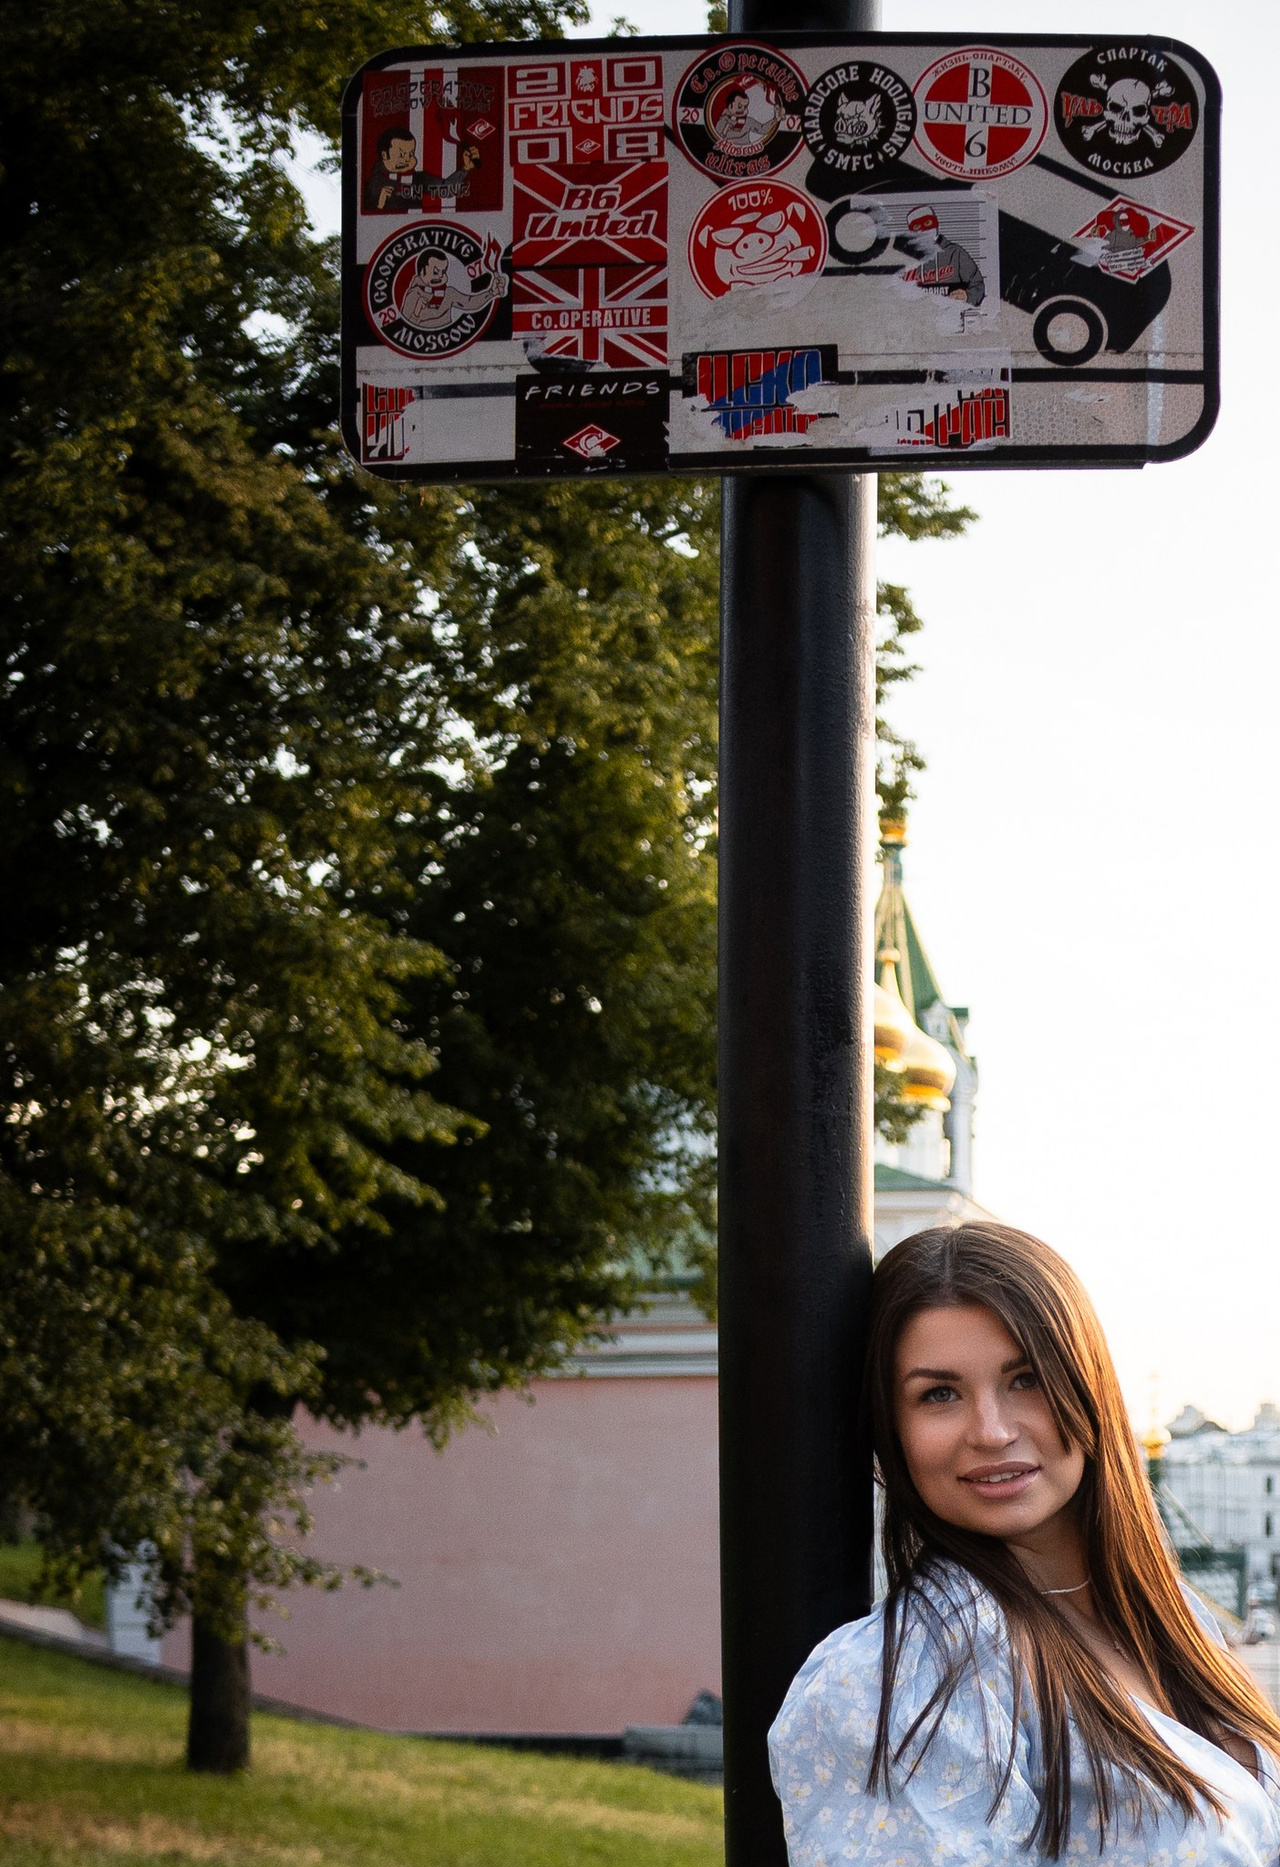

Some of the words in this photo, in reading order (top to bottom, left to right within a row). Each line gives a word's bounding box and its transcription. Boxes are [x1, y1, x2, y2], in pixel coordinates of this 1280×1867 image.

[1096, 46, 1169, 73] СПАРТАК
[513, 94, 664, 129] FRIENDS
[680, 107, 701, 124] 20
[804, 65, 860, 145] HARDCORE
[869, 67, 913, 158] HOOLIGANS
[924, 102, 1032, 126] UNITED
[823, 147, 875, 172] SMFC
[1087, 152, 1154, 175] МОСКВА
[400, 183, 423, 201] ON
[728, 187, 774, 212] 100%
[525, 210, 658, 241] United
[378, 307, 398, 327] 20
[531, 307, 652, 330] Co.OPERATIVE
[393, 313, 477, 352] MOSCOW
[524, 381, 661, 401] FRIENDS
